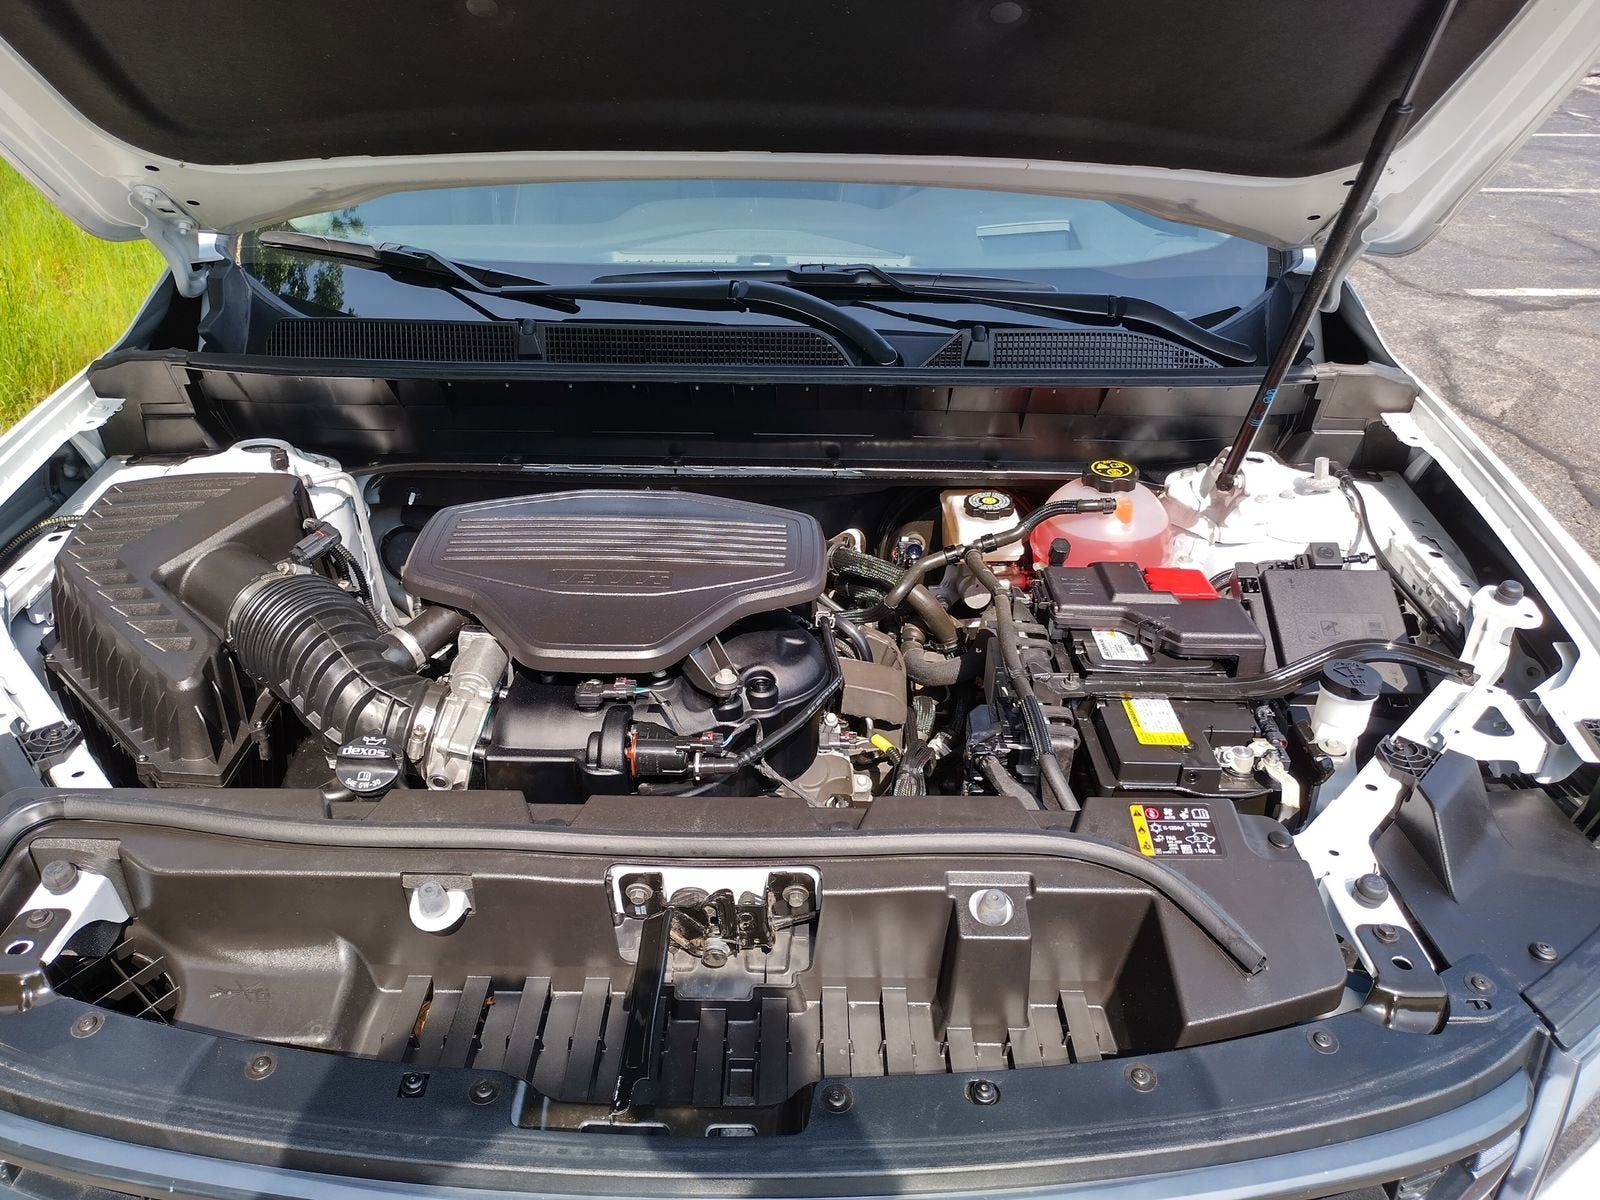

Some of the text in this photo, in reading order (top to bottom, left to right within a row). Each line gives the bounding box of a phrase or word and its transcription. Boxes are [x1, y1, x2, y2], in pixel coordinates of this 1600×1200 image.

[342, 746, 388, 756] dexos
[345, 778, 382, 788] SAE 5W-30
